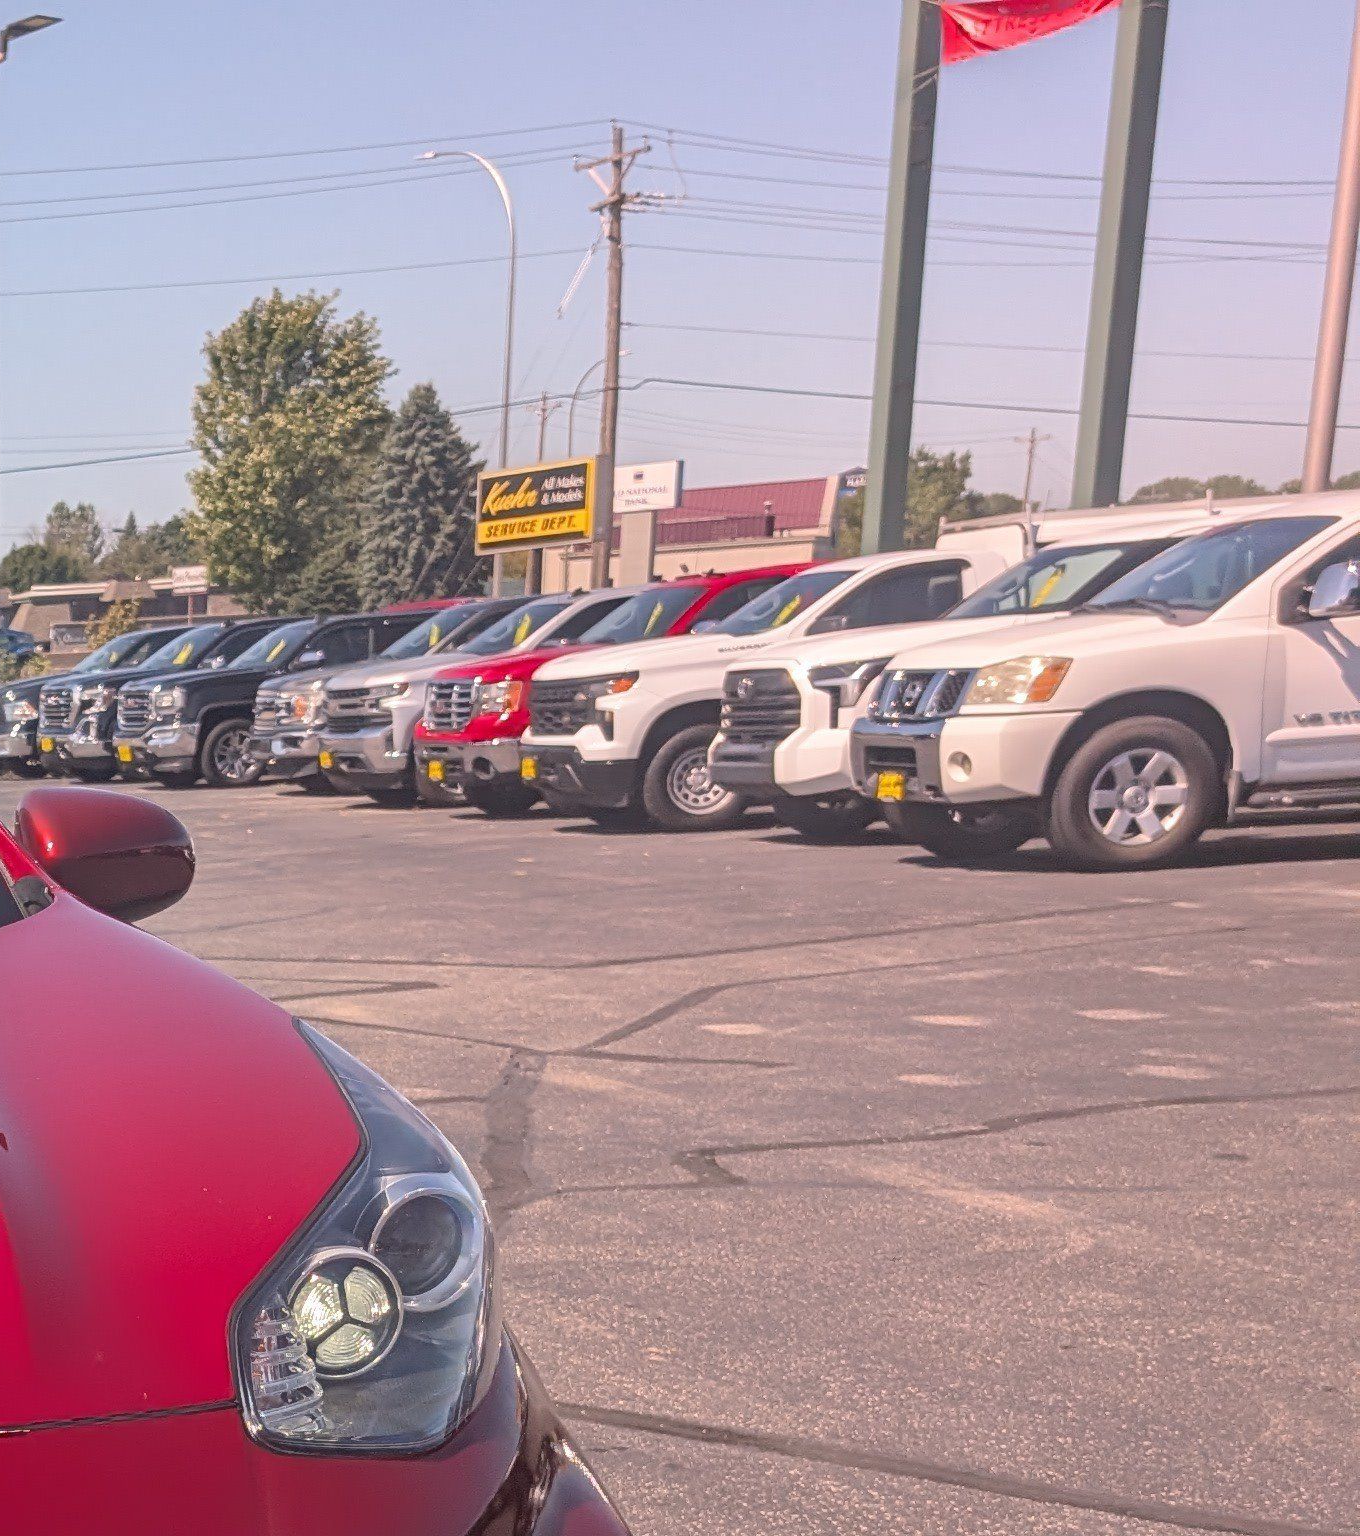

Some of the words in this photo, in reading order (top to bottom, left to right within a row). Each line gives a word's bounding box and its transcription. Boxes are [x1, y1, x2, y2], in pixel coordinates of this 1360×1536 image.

[482, 476, 539, 516] Kuehn
[486, 519, 535, 538] SERVICE
[541, 514, 576, 531] DEPT.
